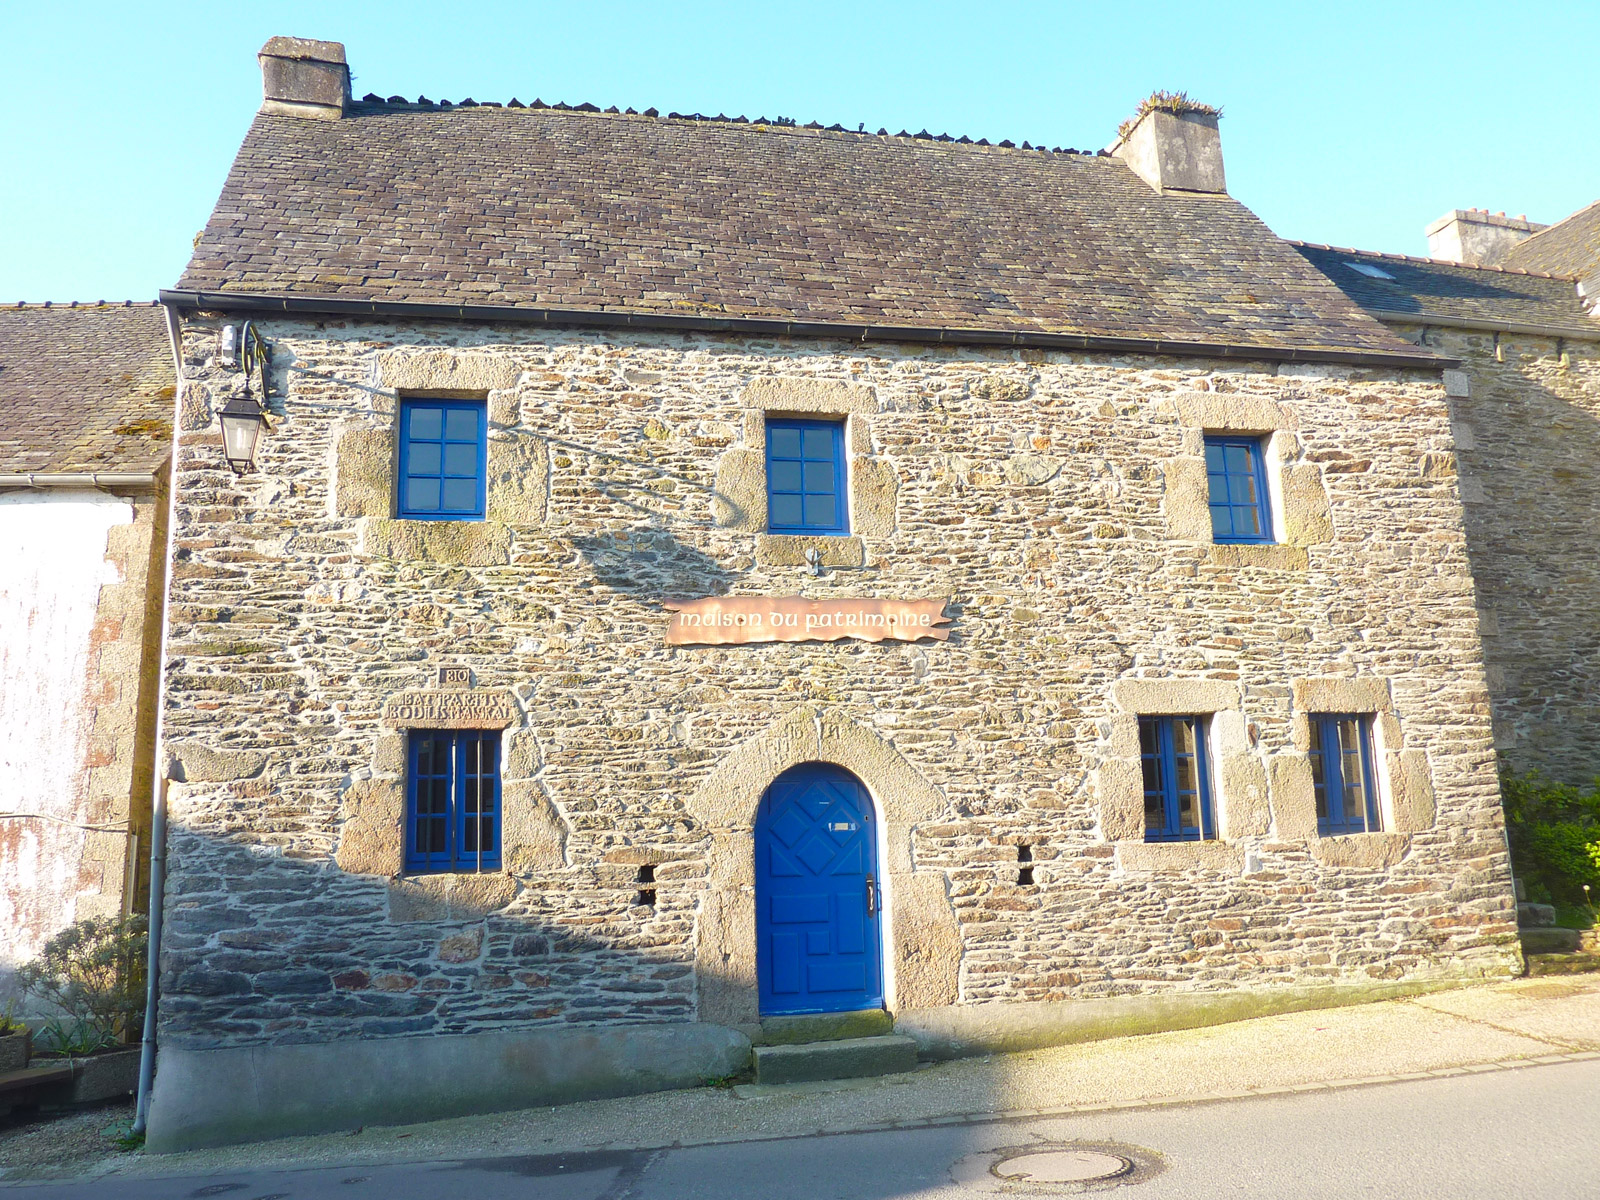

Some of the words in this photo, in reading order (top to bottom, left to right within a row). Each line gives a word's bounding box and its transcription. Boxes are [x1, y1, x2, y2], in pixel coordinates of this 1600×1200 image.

[679, 609, 762, 627] maison
[769, 611, 798, 627] du
[805, 610, 931, 632] patrimoine
